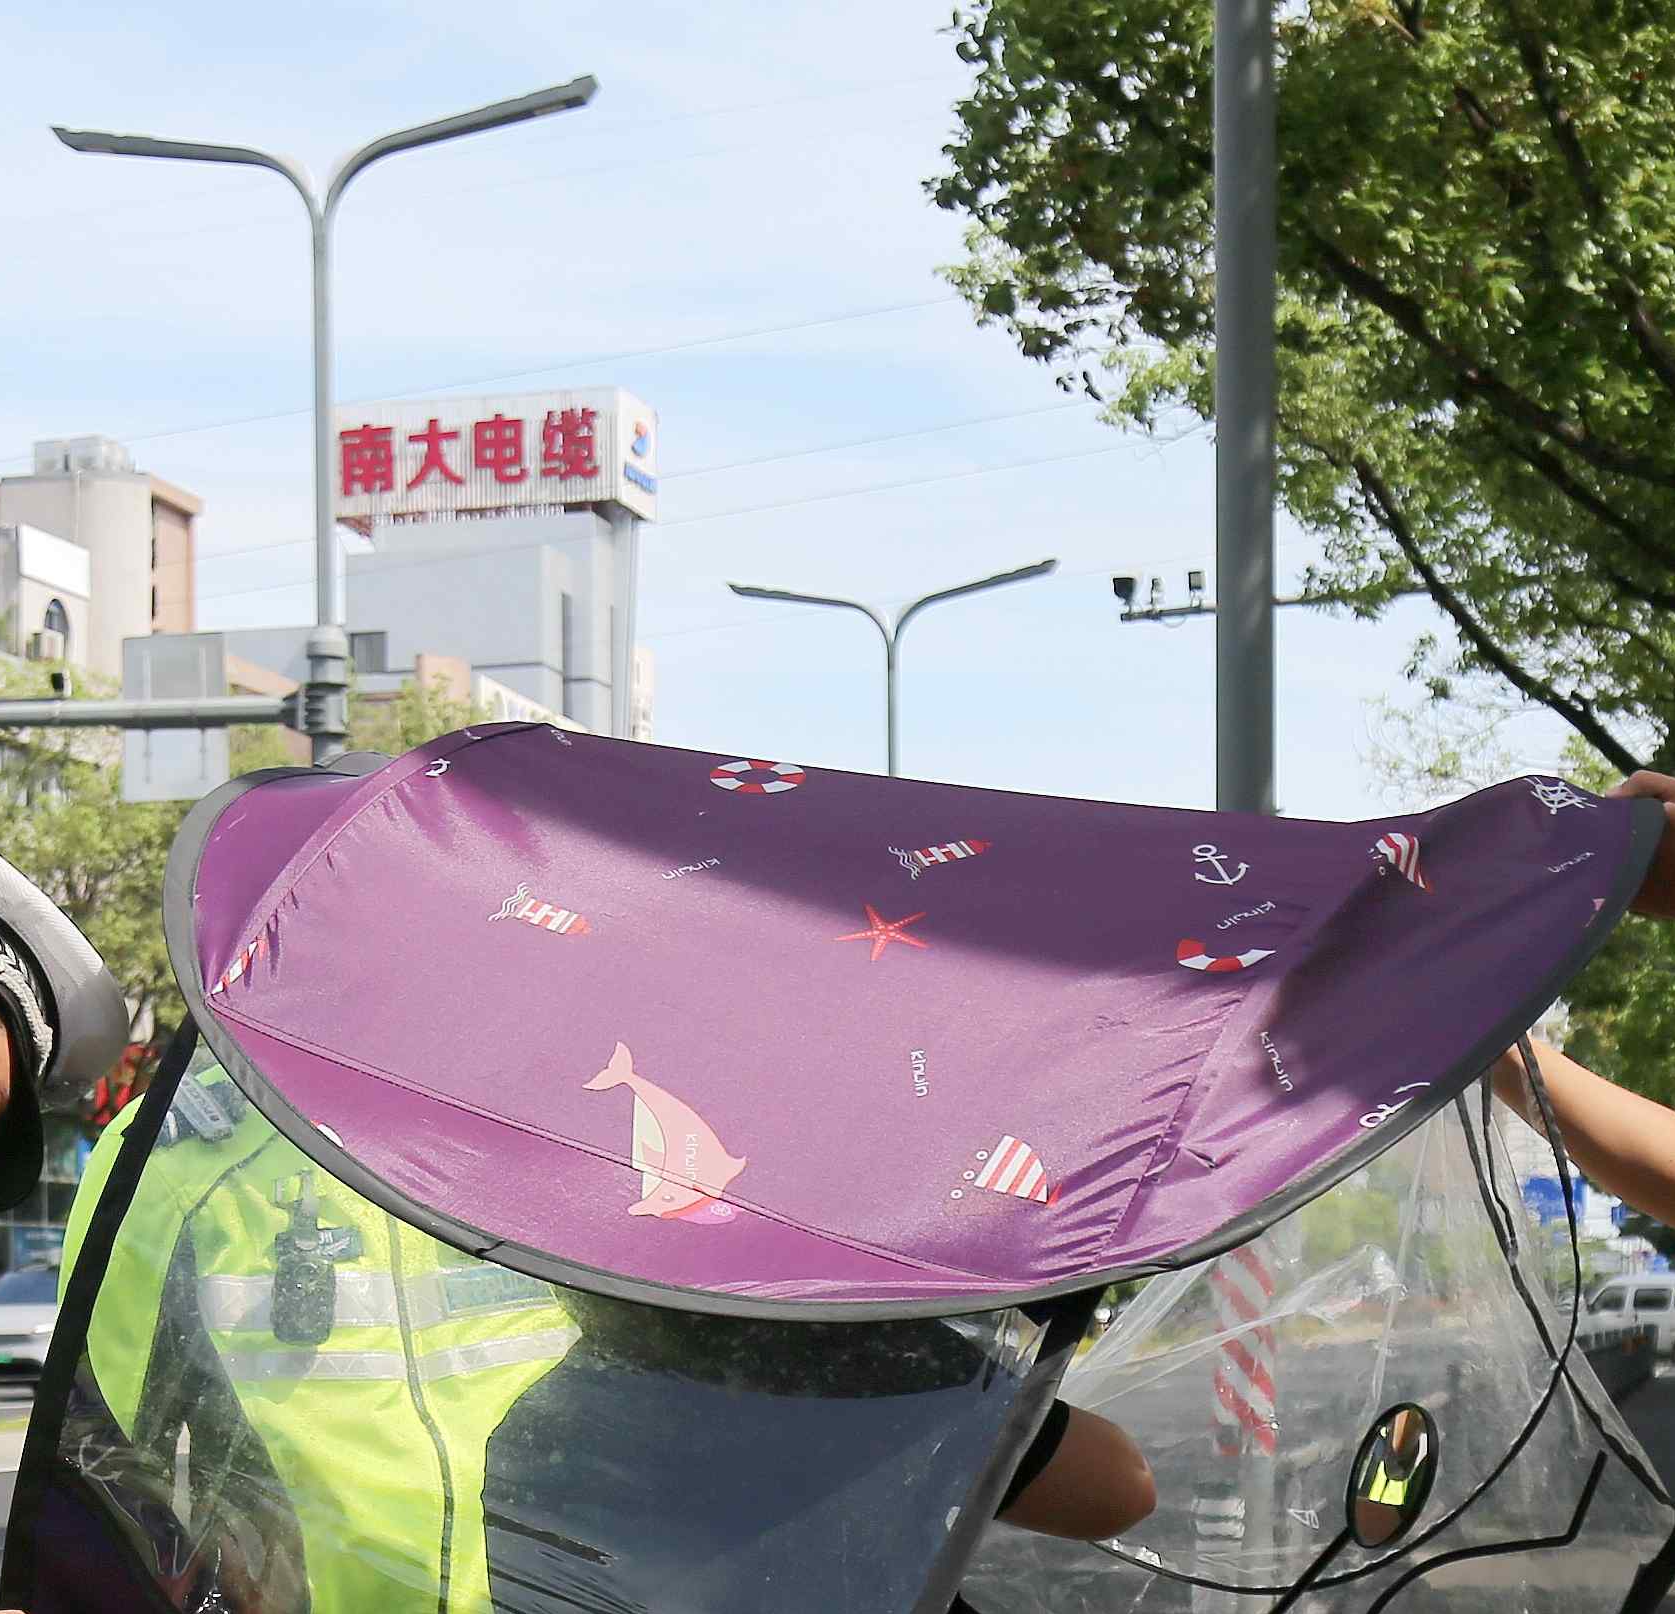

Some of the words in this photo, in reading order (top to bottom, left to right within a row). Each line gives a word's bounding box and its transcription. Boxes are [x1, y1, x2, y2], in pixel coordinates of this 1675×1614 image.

[339, 407, 600, 497] 南大电缆
[910, 1049, 928, 1097] kinwin
[1260, 1031, 1294, 1093] kinwin
